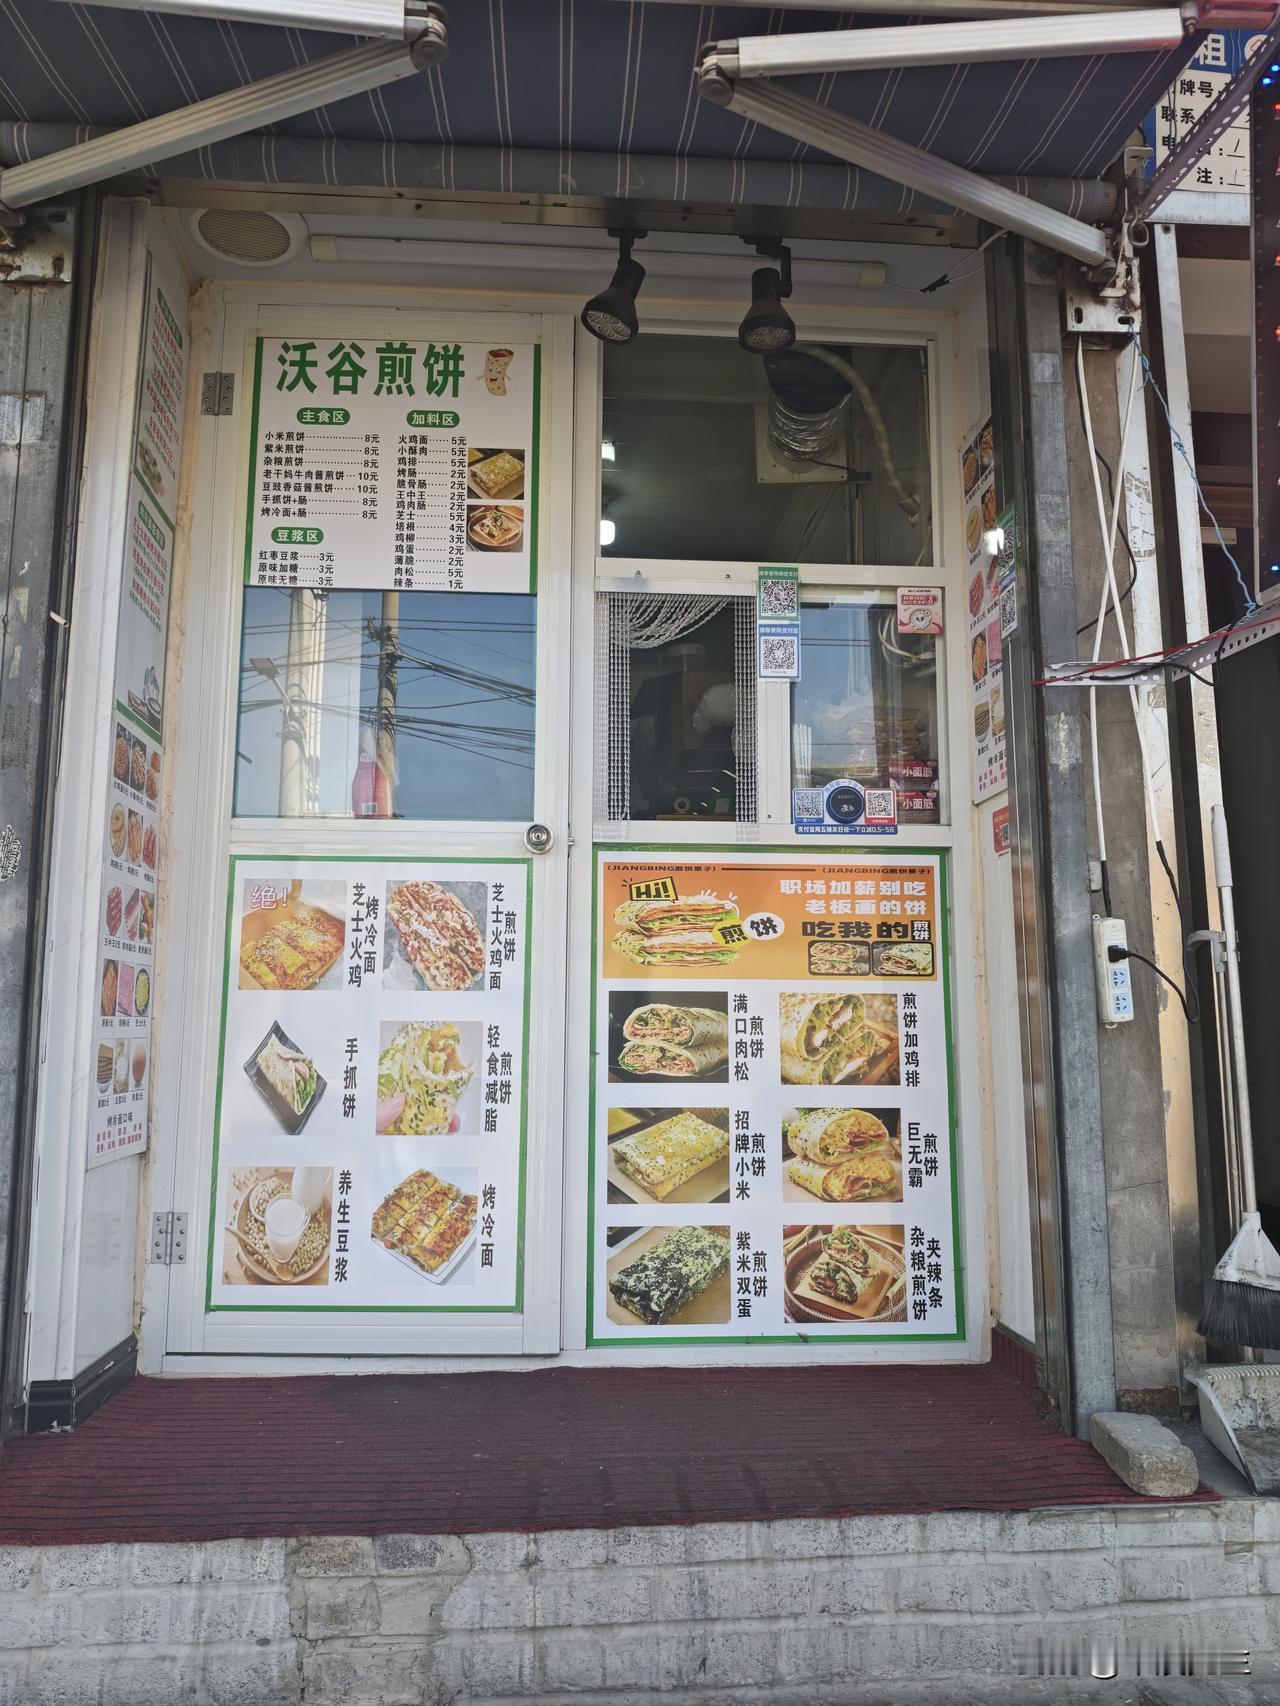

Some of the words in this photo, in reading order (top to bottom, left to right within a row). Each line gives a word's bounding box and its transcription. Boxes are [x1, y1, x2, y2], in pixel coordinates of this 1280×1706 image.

[277, 342, 465, 397] 沃谷煎饼
[302, 410, 345, 423] 主食区
[412, 412, 455, 426] 加料区
[265, 432, 305, 442] 小米煎饼
[365, 434, 380, 444] 8元
[398, 435, 428, 445] 火鸡面
[451, 436, 467, 446] 5元
[264, 444, 304, 454] 紫米煎饼
[364, 446, 379, 456] 8元
[398, 446, 428, 456] 小酥肉
[451, 447, 467, 457] 5元
[263, 456, 303, 467] 杂粮煎饼
[363, 459, 378, 469] 8元
[397, 457, 417, 467] 鸡排
[451, 458, 466, 468] 5元
[263, 469, 344, 480] 老干妈牛肉酱煎饼
[359, 471, 379, 481] 10元
[397, 468, 417, 478] 烤肠
[451, 470, 466, 479] 2元
[262, 482, 333, 493] 豆豉香菇酱煎饼
[358, 485, 378, 494] 10元
[397, 479, 427, 489] 脆骨肠
[450, 481, 466, 490] 2元
[261, 495, 307, 505] 手抓饼+肠
[362, 497, 377, 507] 8元
[396, 490, 426, 500] 王中王
[450, 492, 466, 501] 2元
[396, 500, 426, 510] 鸡肉肠
[450, 502, 465, 511] 2元
[261, 507, 307, 518] 烤冷面+肠
[362, 510, 377, 519] 8元
[396, 511, 415, 520] 芝士
[450, 512, 465, 521] 5元
[395, 522, 415, 532] 培根
[449, 523, 465, 532] 4元
[277, 530, 319, 542] 豆浆区
[395, 533, 415, 543] 鸡柳
[449, 534, 464, 544] 3元
[394, 544, 414, 554] 鸡蛋
[449, 546, 464, 555] 2元
[259, 551, 299, 561] 红枣豆浆
[319, 552, 334, 562] 3元
[394, 555, 414, 565] 薄脆
[449, 557, 464, 567] 2元
[258, 563, 298, 573] 原味加糖
[318, 565, 334, 574] 3元
[393, 567, 414, 576] 肉松
[448, 569, 463, 578] 5元
[257, 575, 298, 585] 原味无糖
[318, 576, 333, 586] 3元
[393, 578, 413, 588] 辣条
[449, 580, 463, 589] 1元
[903, 798, 933, 809] 小面筋
[780, 879, 927, 896] 职场加薪别吃
[805, 899, 927, 915] 老板画的饼
[348, 882, 366, 988] 芝士火鸡
[364, 896, 379, 975] 烤冷面
[489, 882, 505, 990] 芝士火鸡面
[504, 911, 518, 962] 煎饼
[802, 921, 908, 939] 吃我的
[734, 993, 749, 1082] 满口肉松
[749, 1015, 764, 1059] 煎饼
[903, 993, 920, 1087] 煎饼加鸡排
[343, 1038, 359, 1119] 手抓饼
[484, 1024, 500, 1134] 轻食减脂
[500, 1051, 513, 1105] 煎饼
[735, 1109, 750, 1200] 招牌小米
[751, 1132, 766, 1177] 煎饼
[908, 1123, 923, 1188] 巨无霸
[923, 1132, 938, 1177] 煎饼
[334, 1169, 352, 1283] 养生豆浆
[480, 1184, 496, 1269] 烤冷面
[736, 1231, 752, 1318] 紫米双蛋
[752, 1250, 768, 1298] 煎饼
[910, 1225, 927, 1321] 杂粮煎饼
[926, 1237, 943, 1308] 夹辣条
